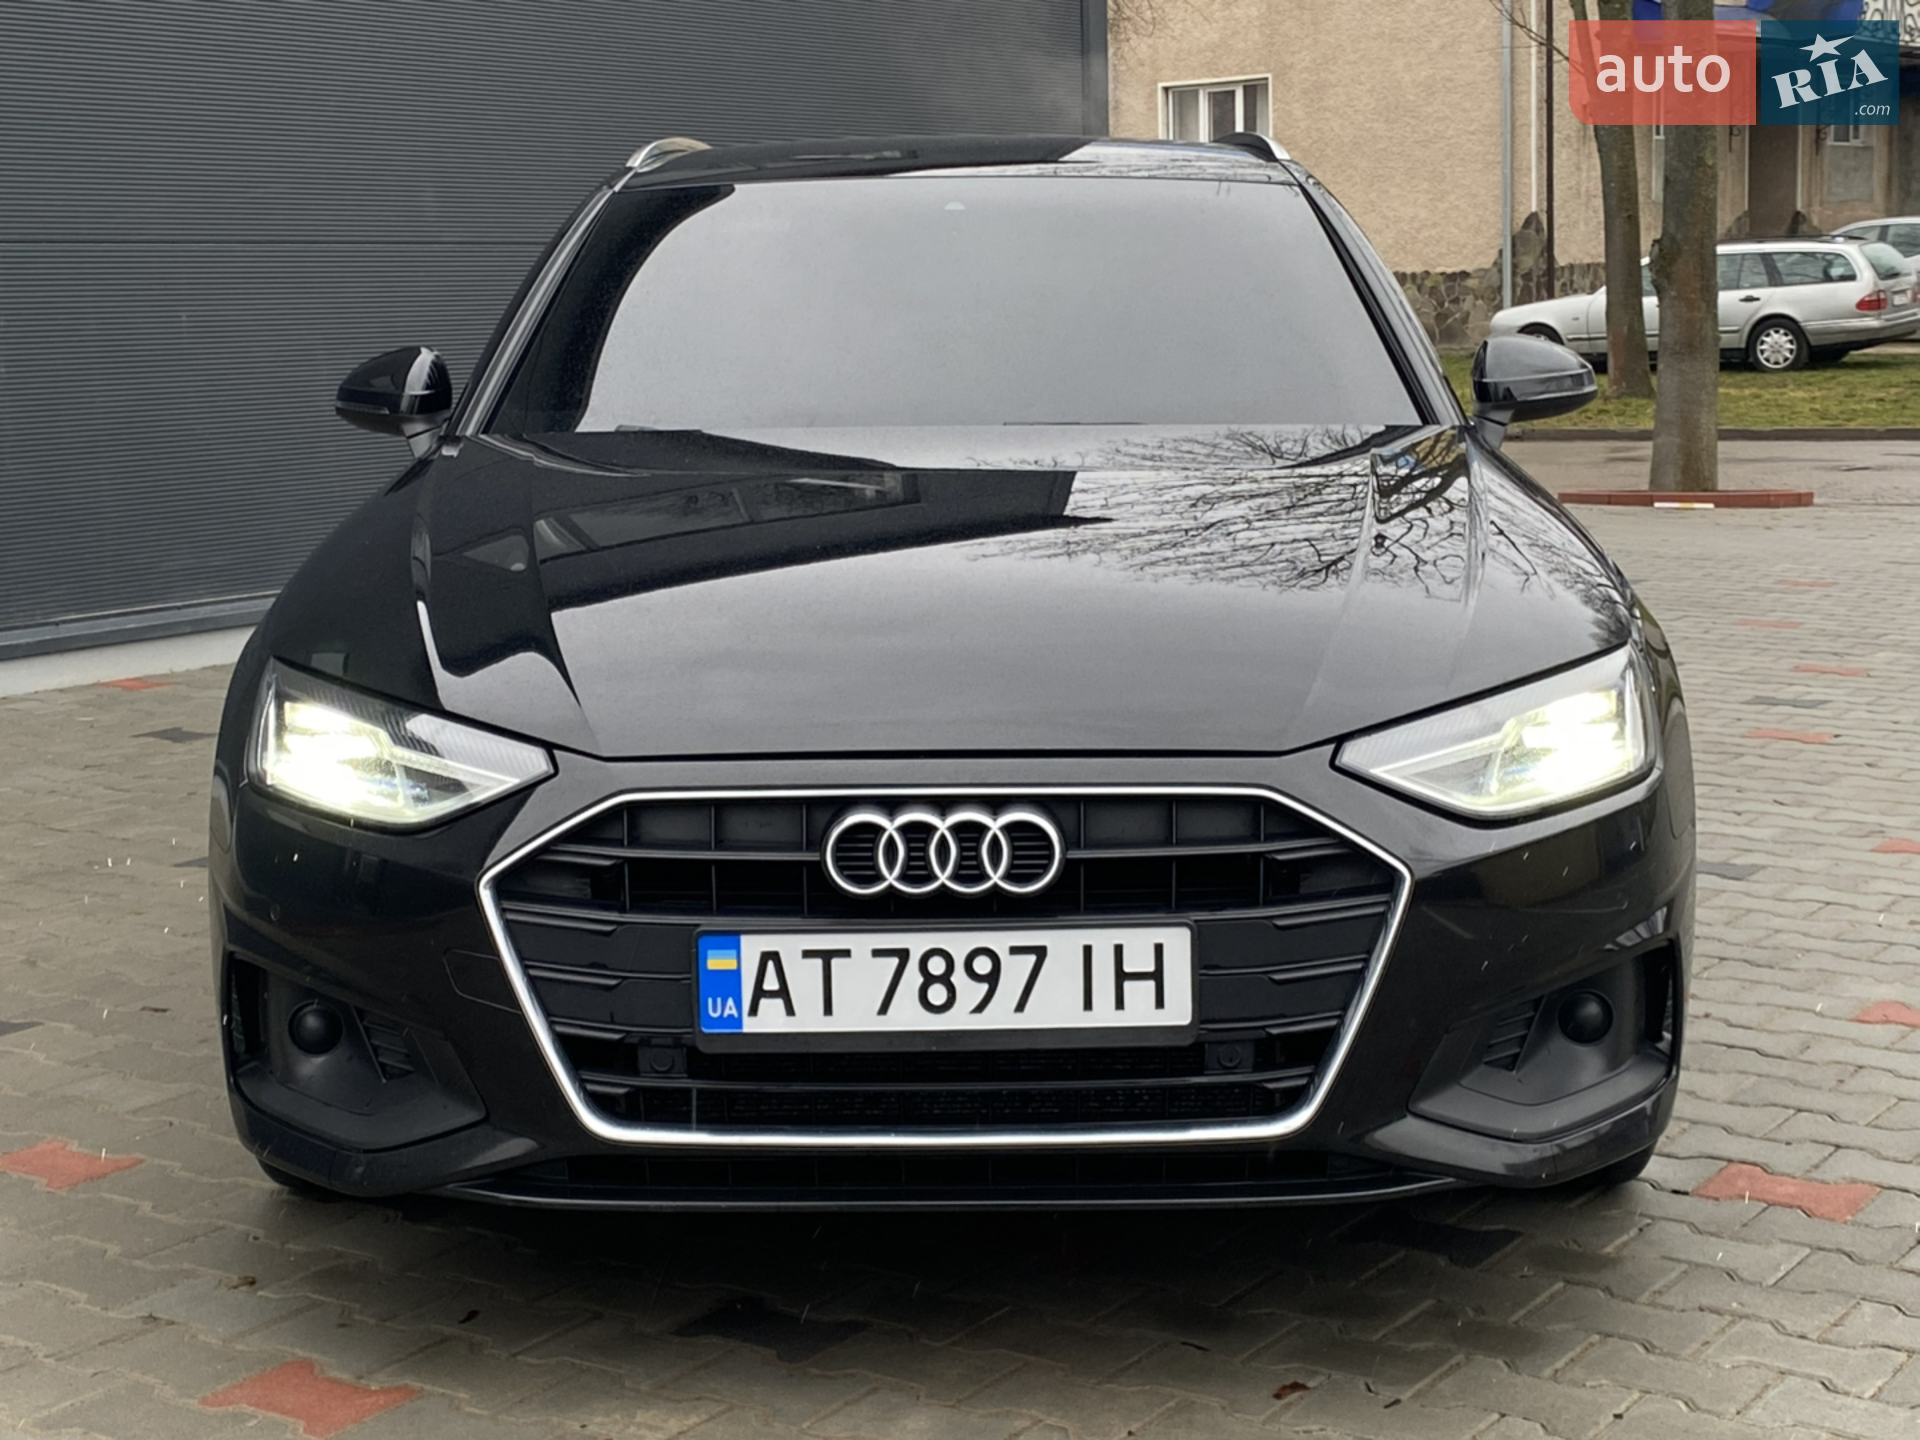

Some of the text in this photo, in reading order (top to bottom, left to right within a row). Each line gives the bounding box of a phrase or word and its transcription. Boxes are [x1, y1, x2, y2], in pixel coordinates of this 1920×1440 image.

[747, 942, 1165, 1017] AT 7897 IH
[707, 997, 739, 1018] UA
